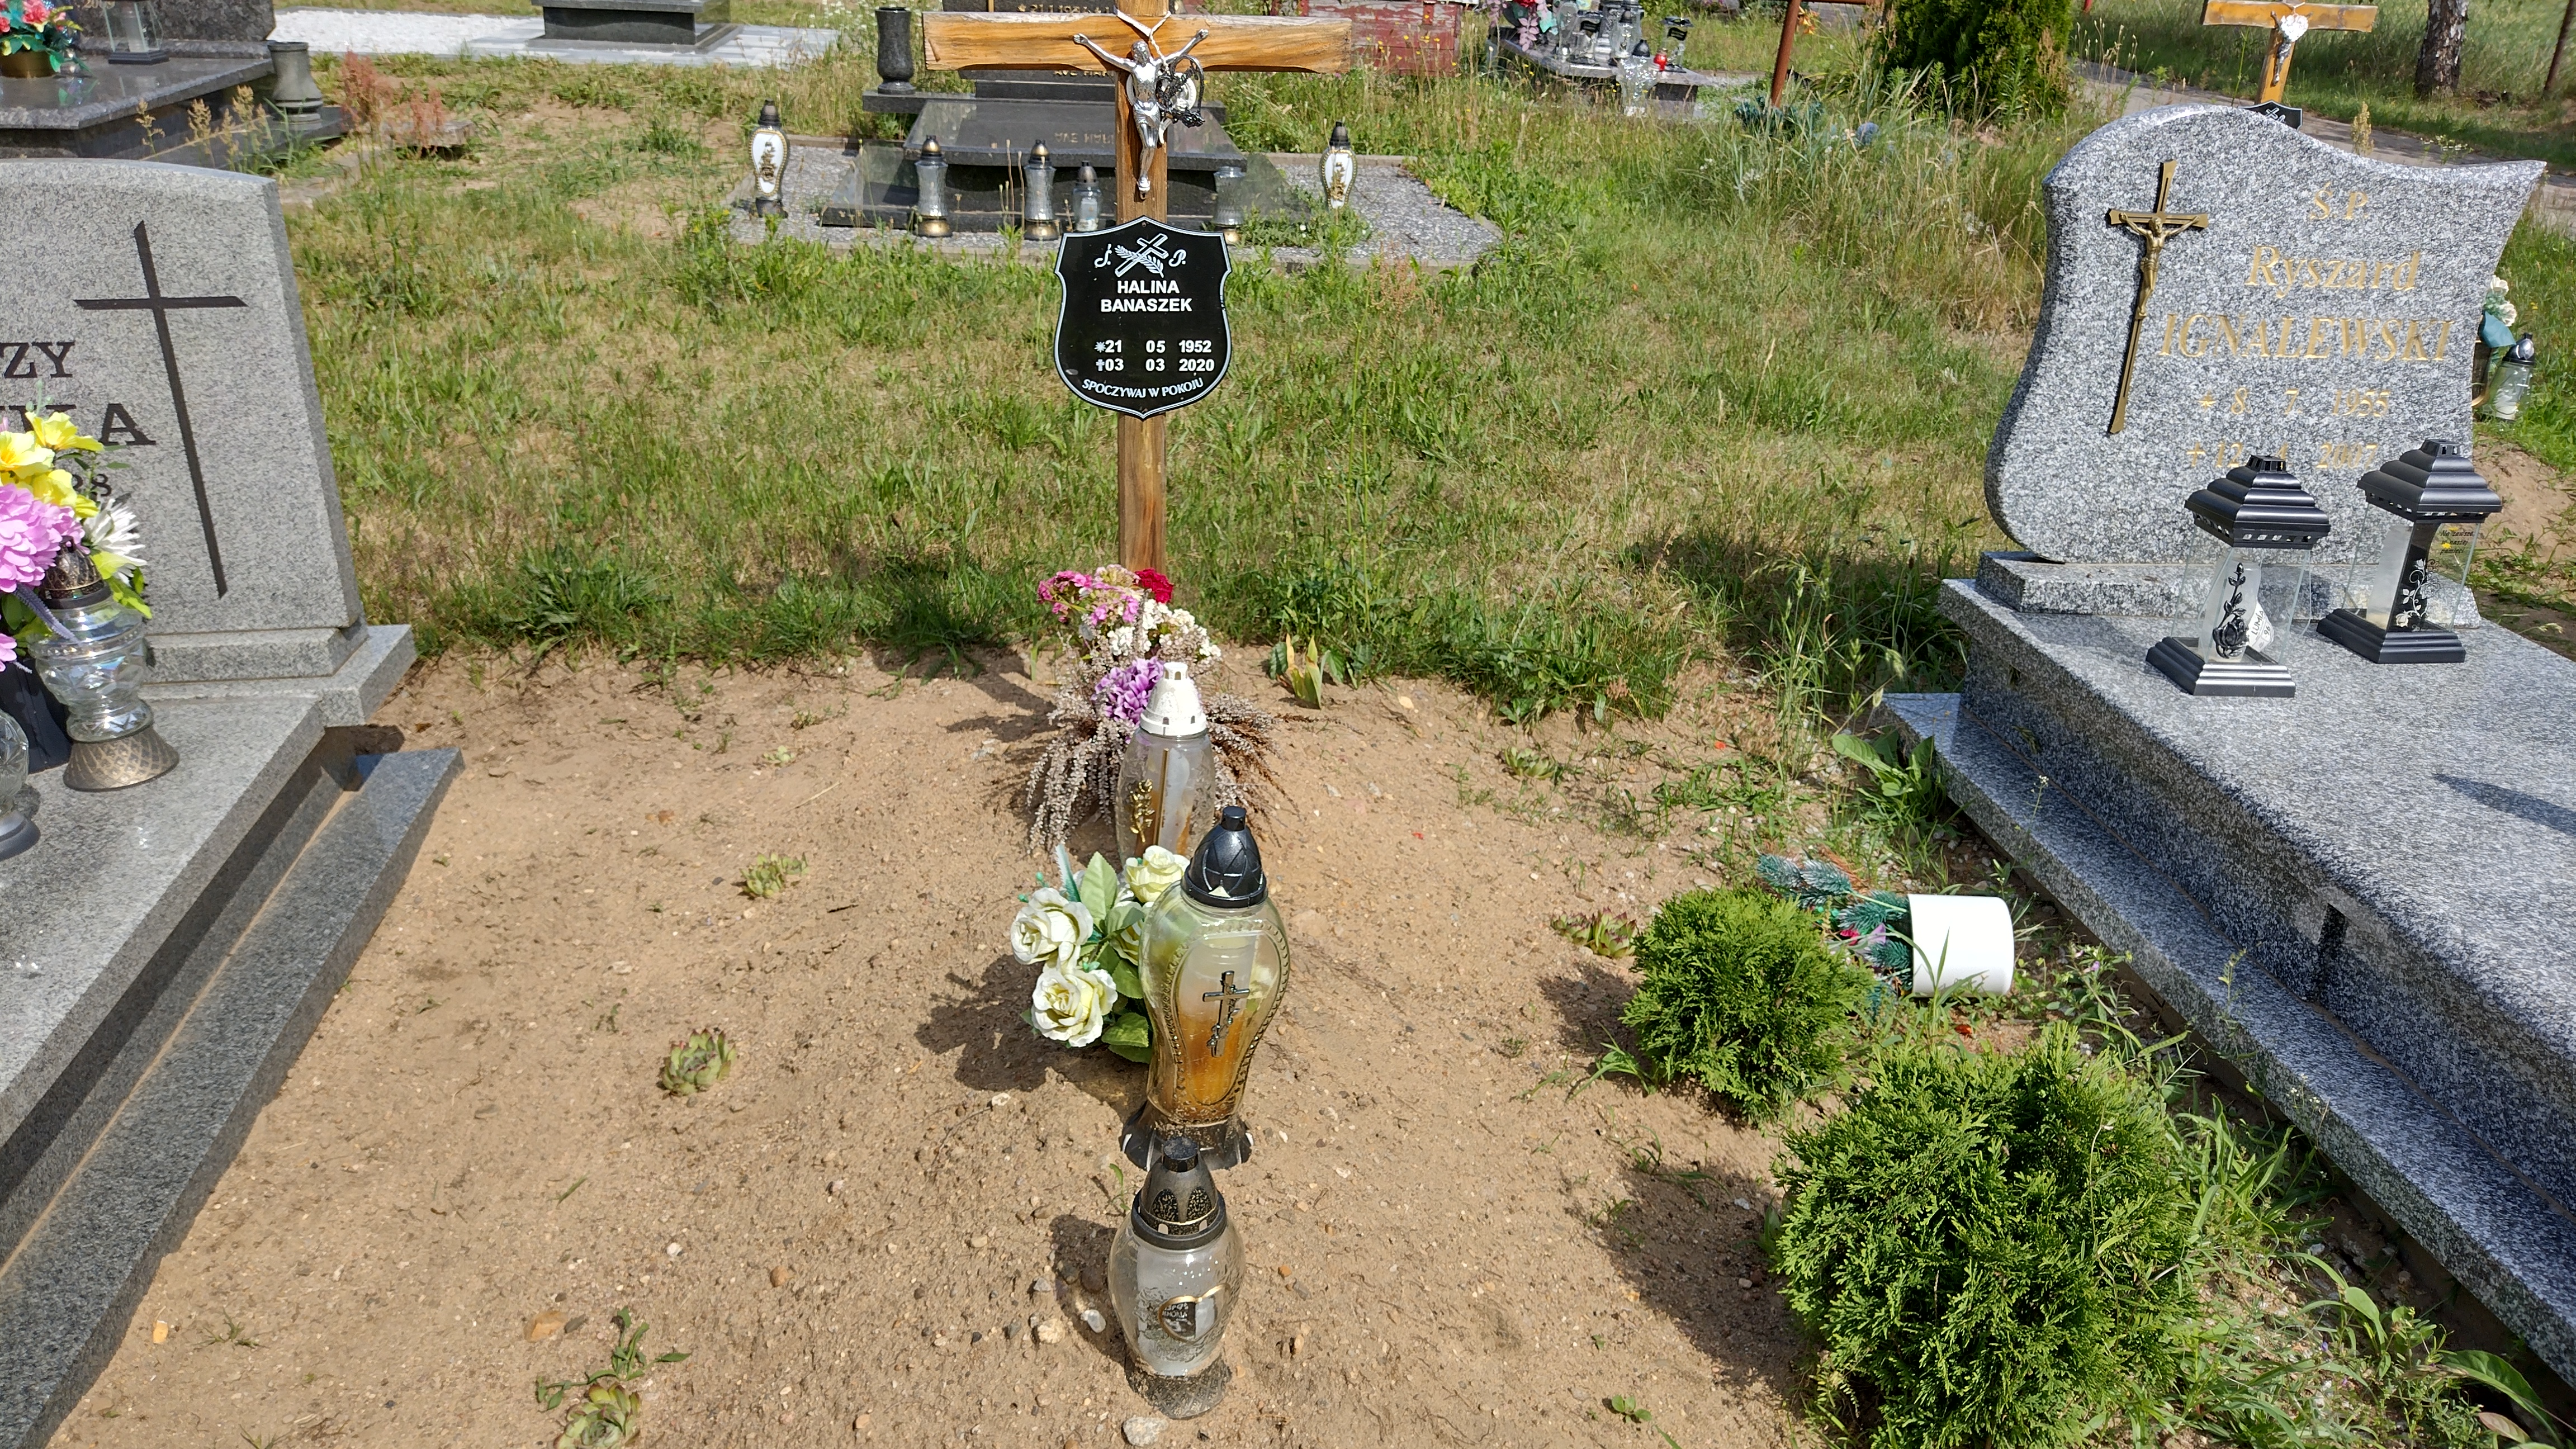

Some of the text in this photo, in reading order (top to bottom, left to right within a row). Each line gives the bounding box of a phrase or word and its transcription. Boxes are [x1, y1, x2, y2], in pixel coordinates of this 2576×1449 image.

[2244, 245, 2421, 298] Ryszard
[1117, 281, 1180, 293] HALINA
[1101, 299, 1192, 312] BANASZEK
[1146, 340, 1166, 353] 05
[1178, 340, 1212, 353] 1952
[2158, 313, 2455, 361] IGNALEWSKI
[1145, 359, 1165, 371] 03
[1178, 359, 1215, 372] 2020
[1082, 378, 1204, 398] SPOCZYWAJ W POKOJU
[2332, 390, 2390, 418] 1955
[2317, 443, 2378, 470] 2007
